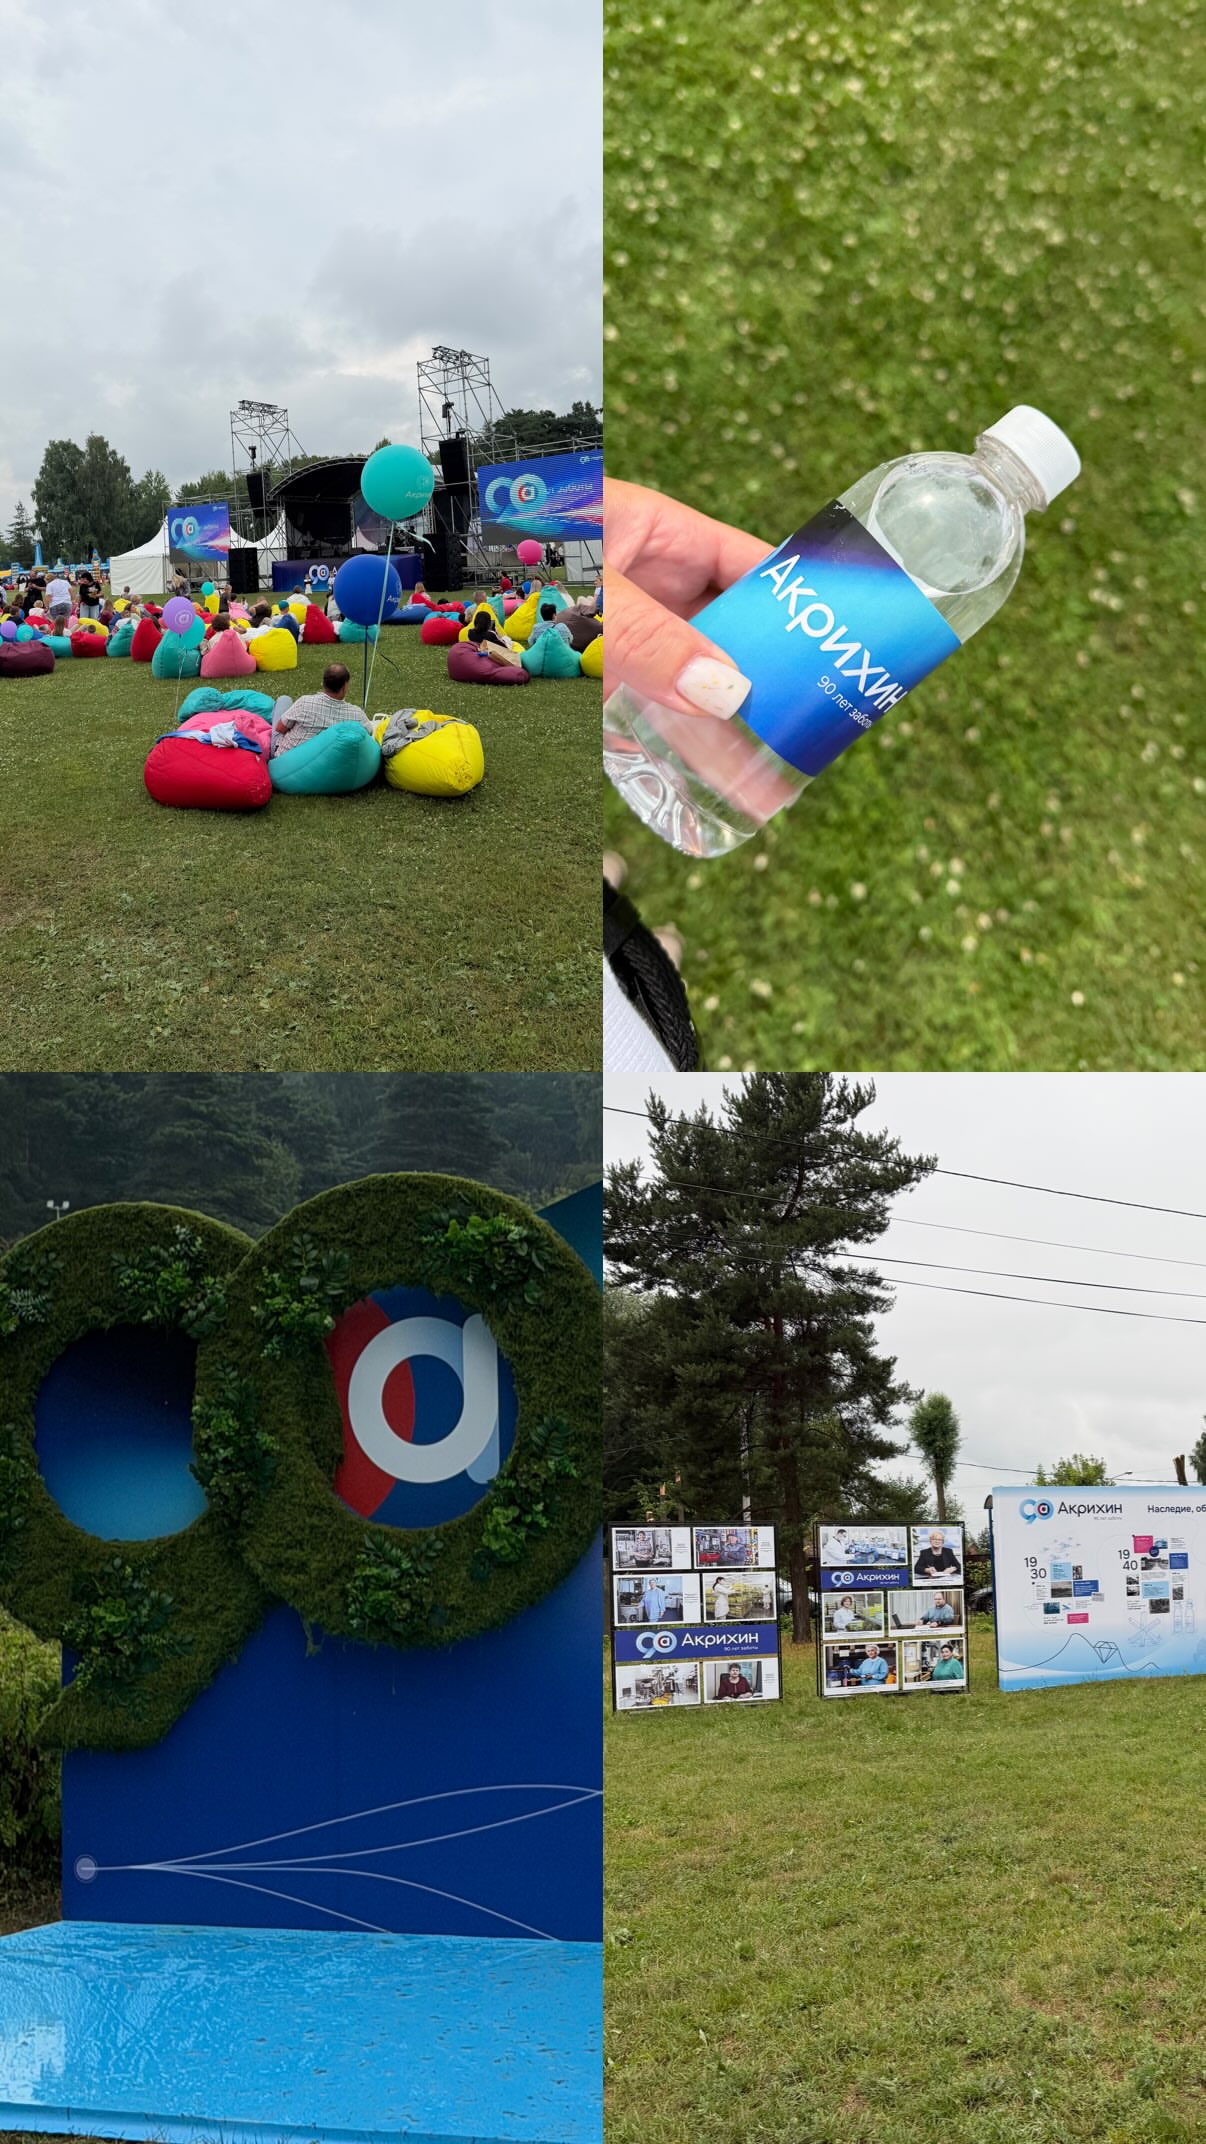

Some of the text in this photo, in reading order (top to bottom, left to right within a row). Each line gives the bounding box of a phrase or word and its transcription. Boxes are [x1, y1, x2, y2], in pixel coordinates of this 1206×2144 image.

[760, 554, 908, 713] Акрихин
[817, 675, 837, 695] 90
[832, 693, 853, 711] лет
[1057, 1501, 1122, 1517] Акрихин
[1147, 1504, 1194, 1514] Наследие,
[1118, 1549, 1131, 1560] 19
[1024, 1556, 1038, 1568] 19
[1122, 1560, 1138, 1571] 40
[856, 1572, 900, 1583] Акрихин
[1030, 1568, 1047, 1579] 30
[681, 1632, 759, 1649] Акрихин
